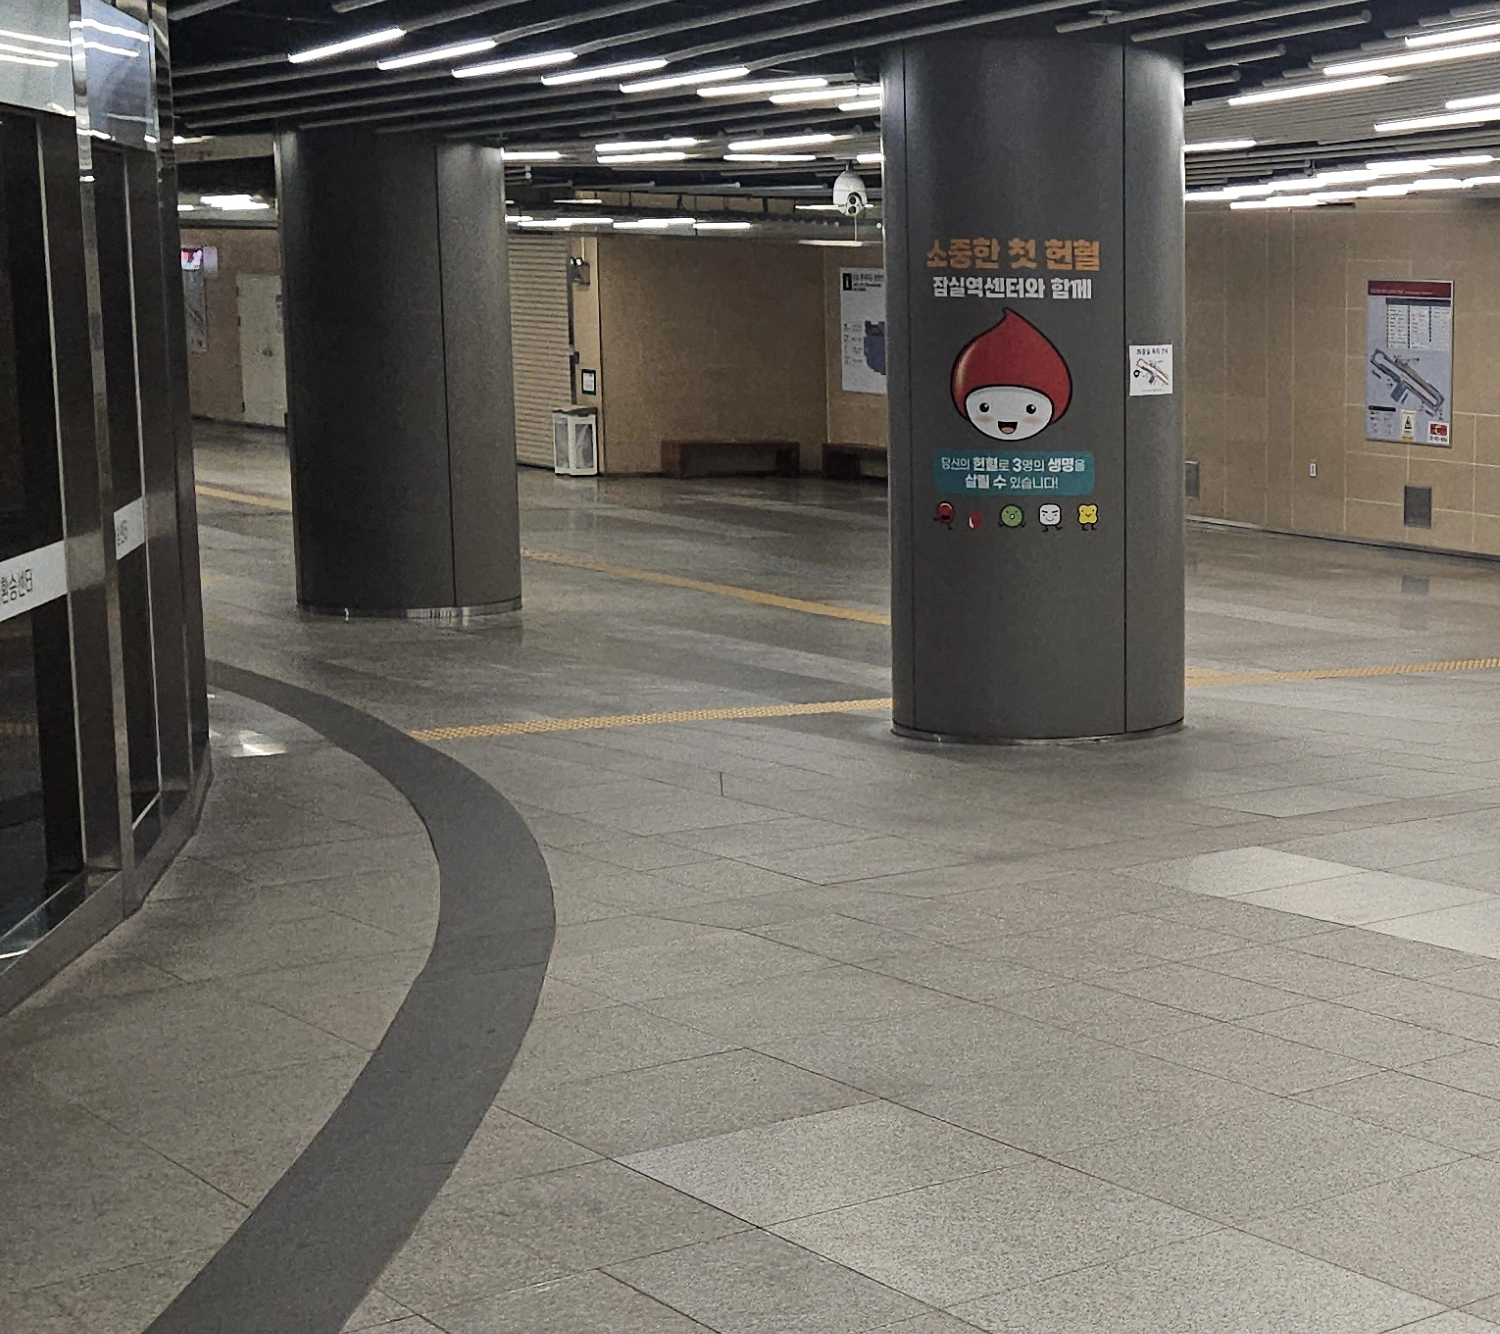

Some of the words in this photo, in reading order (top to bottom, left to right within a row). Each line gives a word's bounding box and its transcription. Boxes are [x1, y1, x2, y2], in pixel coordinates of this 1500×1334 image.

[927, 237, 1000, 269] 소중한
[1008, 237, 1037, 270] 첫
[1044, 238, 1100, 271] 헌혈
[933, 276, 1046, 299] 잠실역센터와
[1051, 277, 1092, 300] 함께
[941, 457, 970, 471] 당신의
[972, 456, 1010, 472] 헌혈로
[1012, 457, 1045, 473] 3명의
[1048, 457, 1086, 473] 생명을
[965, 474, 990, 489] 살릴
[993, 474, 1007, 489] 수
[1010, 476, 1059, 490] 있습니다!
